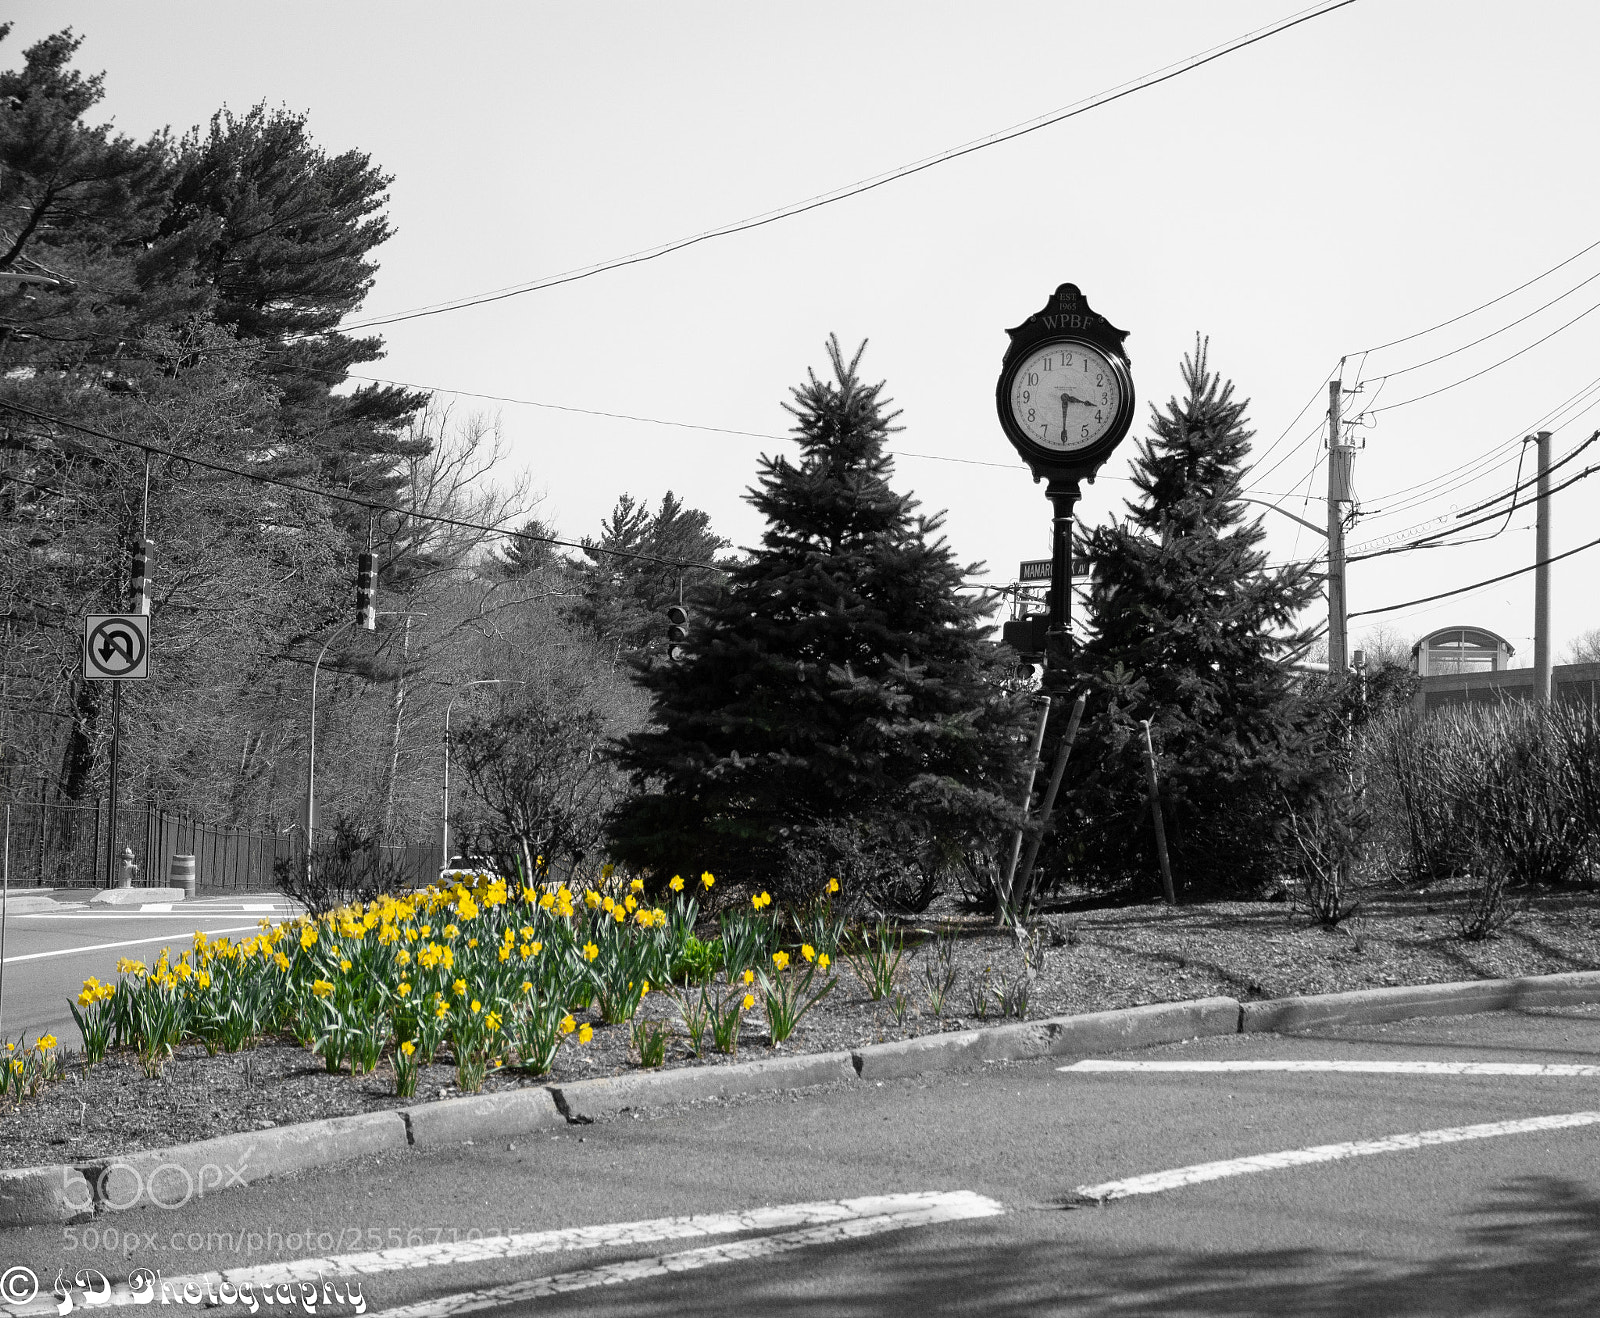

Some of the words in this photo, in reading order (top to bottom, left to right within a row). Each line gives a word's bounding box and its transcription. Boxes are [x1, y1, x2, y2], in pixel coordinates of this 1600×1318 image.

[1060, 303, 1077, 311] 1965
[1042, 314, 1094, 330] WPBF
[1043, 358, 1052, 371] 11
[1061, 353, 1073, 366] 12
[1084, 359, 1088, 372] 1
[1028, 373, 1039, 386] 10
[1096, 374, 1103, 387] 2
[1023, 391, 1030, 404] 9
[1102, 392, 1108, 405] 3
[1028, 409, 1035, 422] 8
[1095, 410, 1102, 423] 4
[1041, 424, 1048, 438] 7
[1081, 424, 1089, 437] 5
